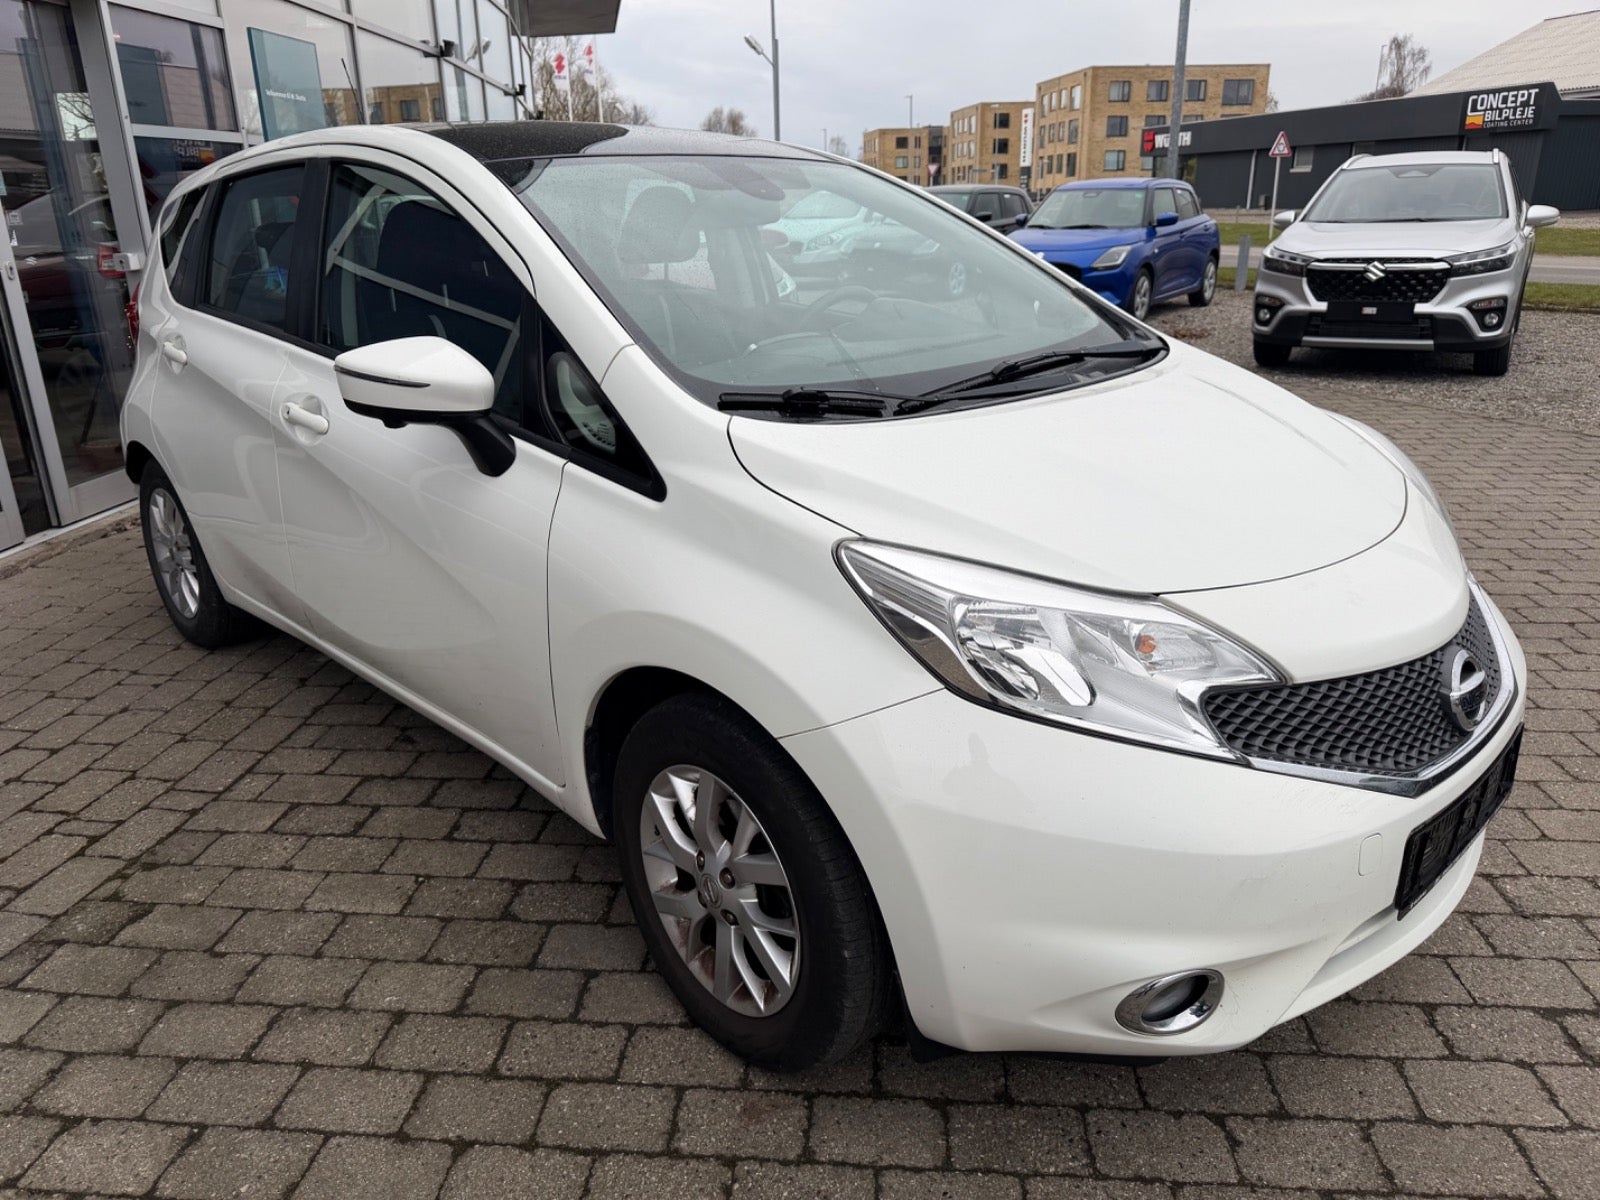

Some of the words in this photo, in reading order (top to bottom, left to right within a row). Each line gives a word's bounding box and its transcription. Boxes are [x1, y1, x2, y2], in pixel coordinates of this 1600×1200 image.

[1467, 88, 1539, 116] CONCEPT
[1484, 106, 1536, 121] BILPLEJE
[1483, 121, 1508, 129] COATING
[1509, 119, 1534, 127] CENTER
[1155, 131, 1192, 149] WÜTH
